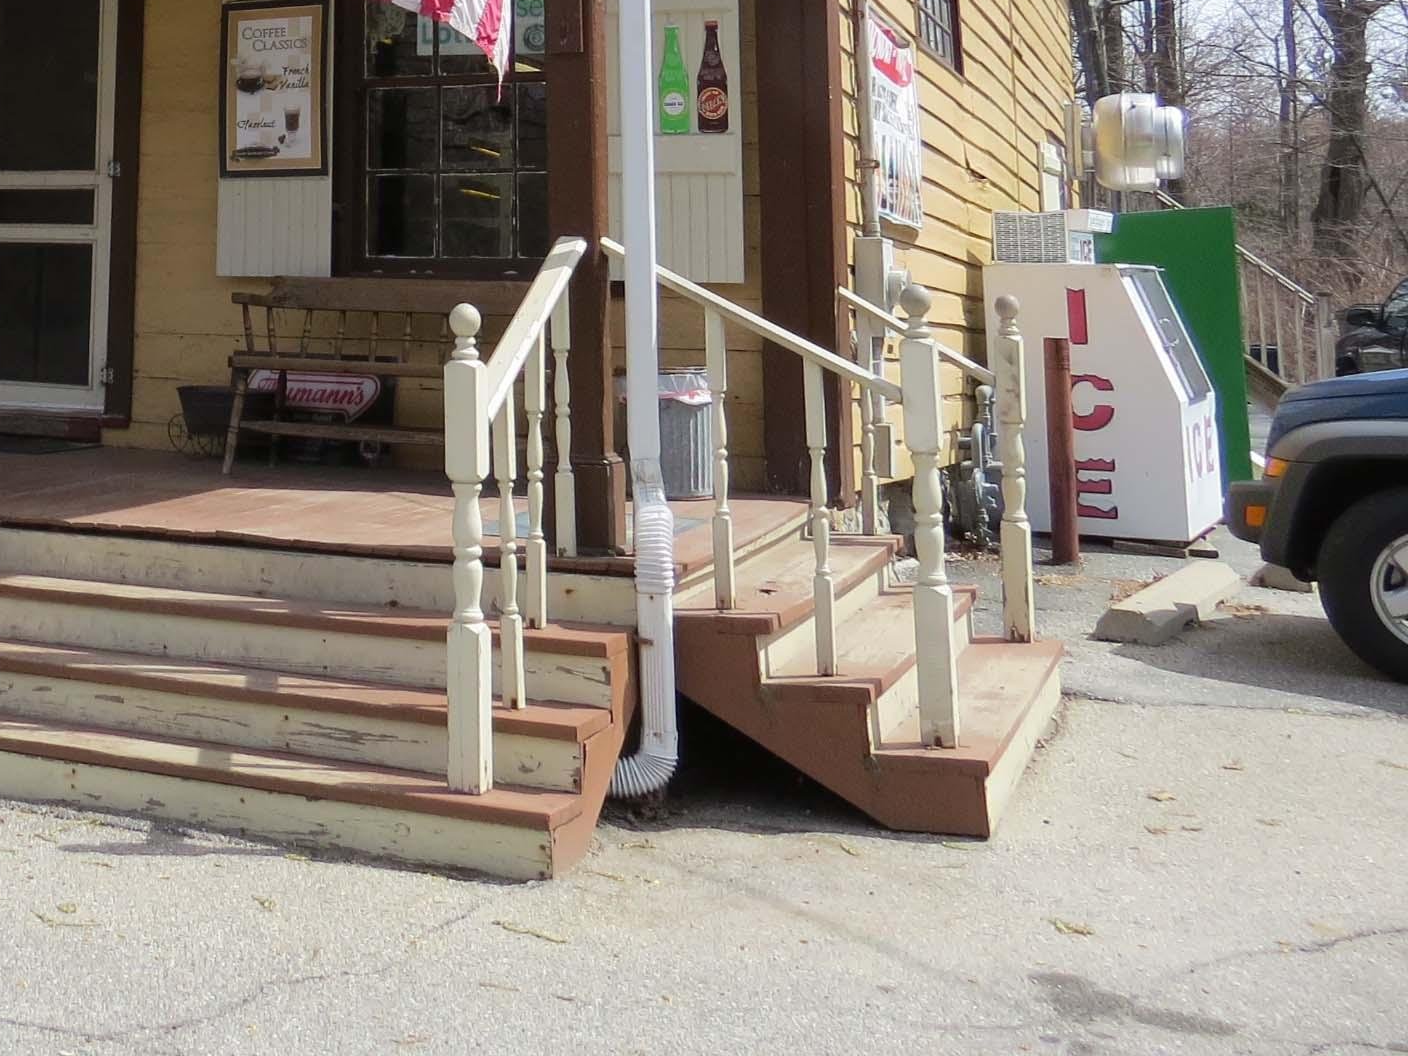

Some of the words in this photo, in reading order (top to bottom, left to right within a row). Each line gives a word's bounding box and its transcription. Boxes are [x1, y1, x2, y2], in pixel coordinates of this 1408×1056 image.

[242, 27, 287, 40] COFFEE
[252, 38, 307, 52] CLASSICS
[282, 63, 309, 75] French
[1066, 288, 1118, 520] ICE
[1186, 415, 1215, 485] ICE
